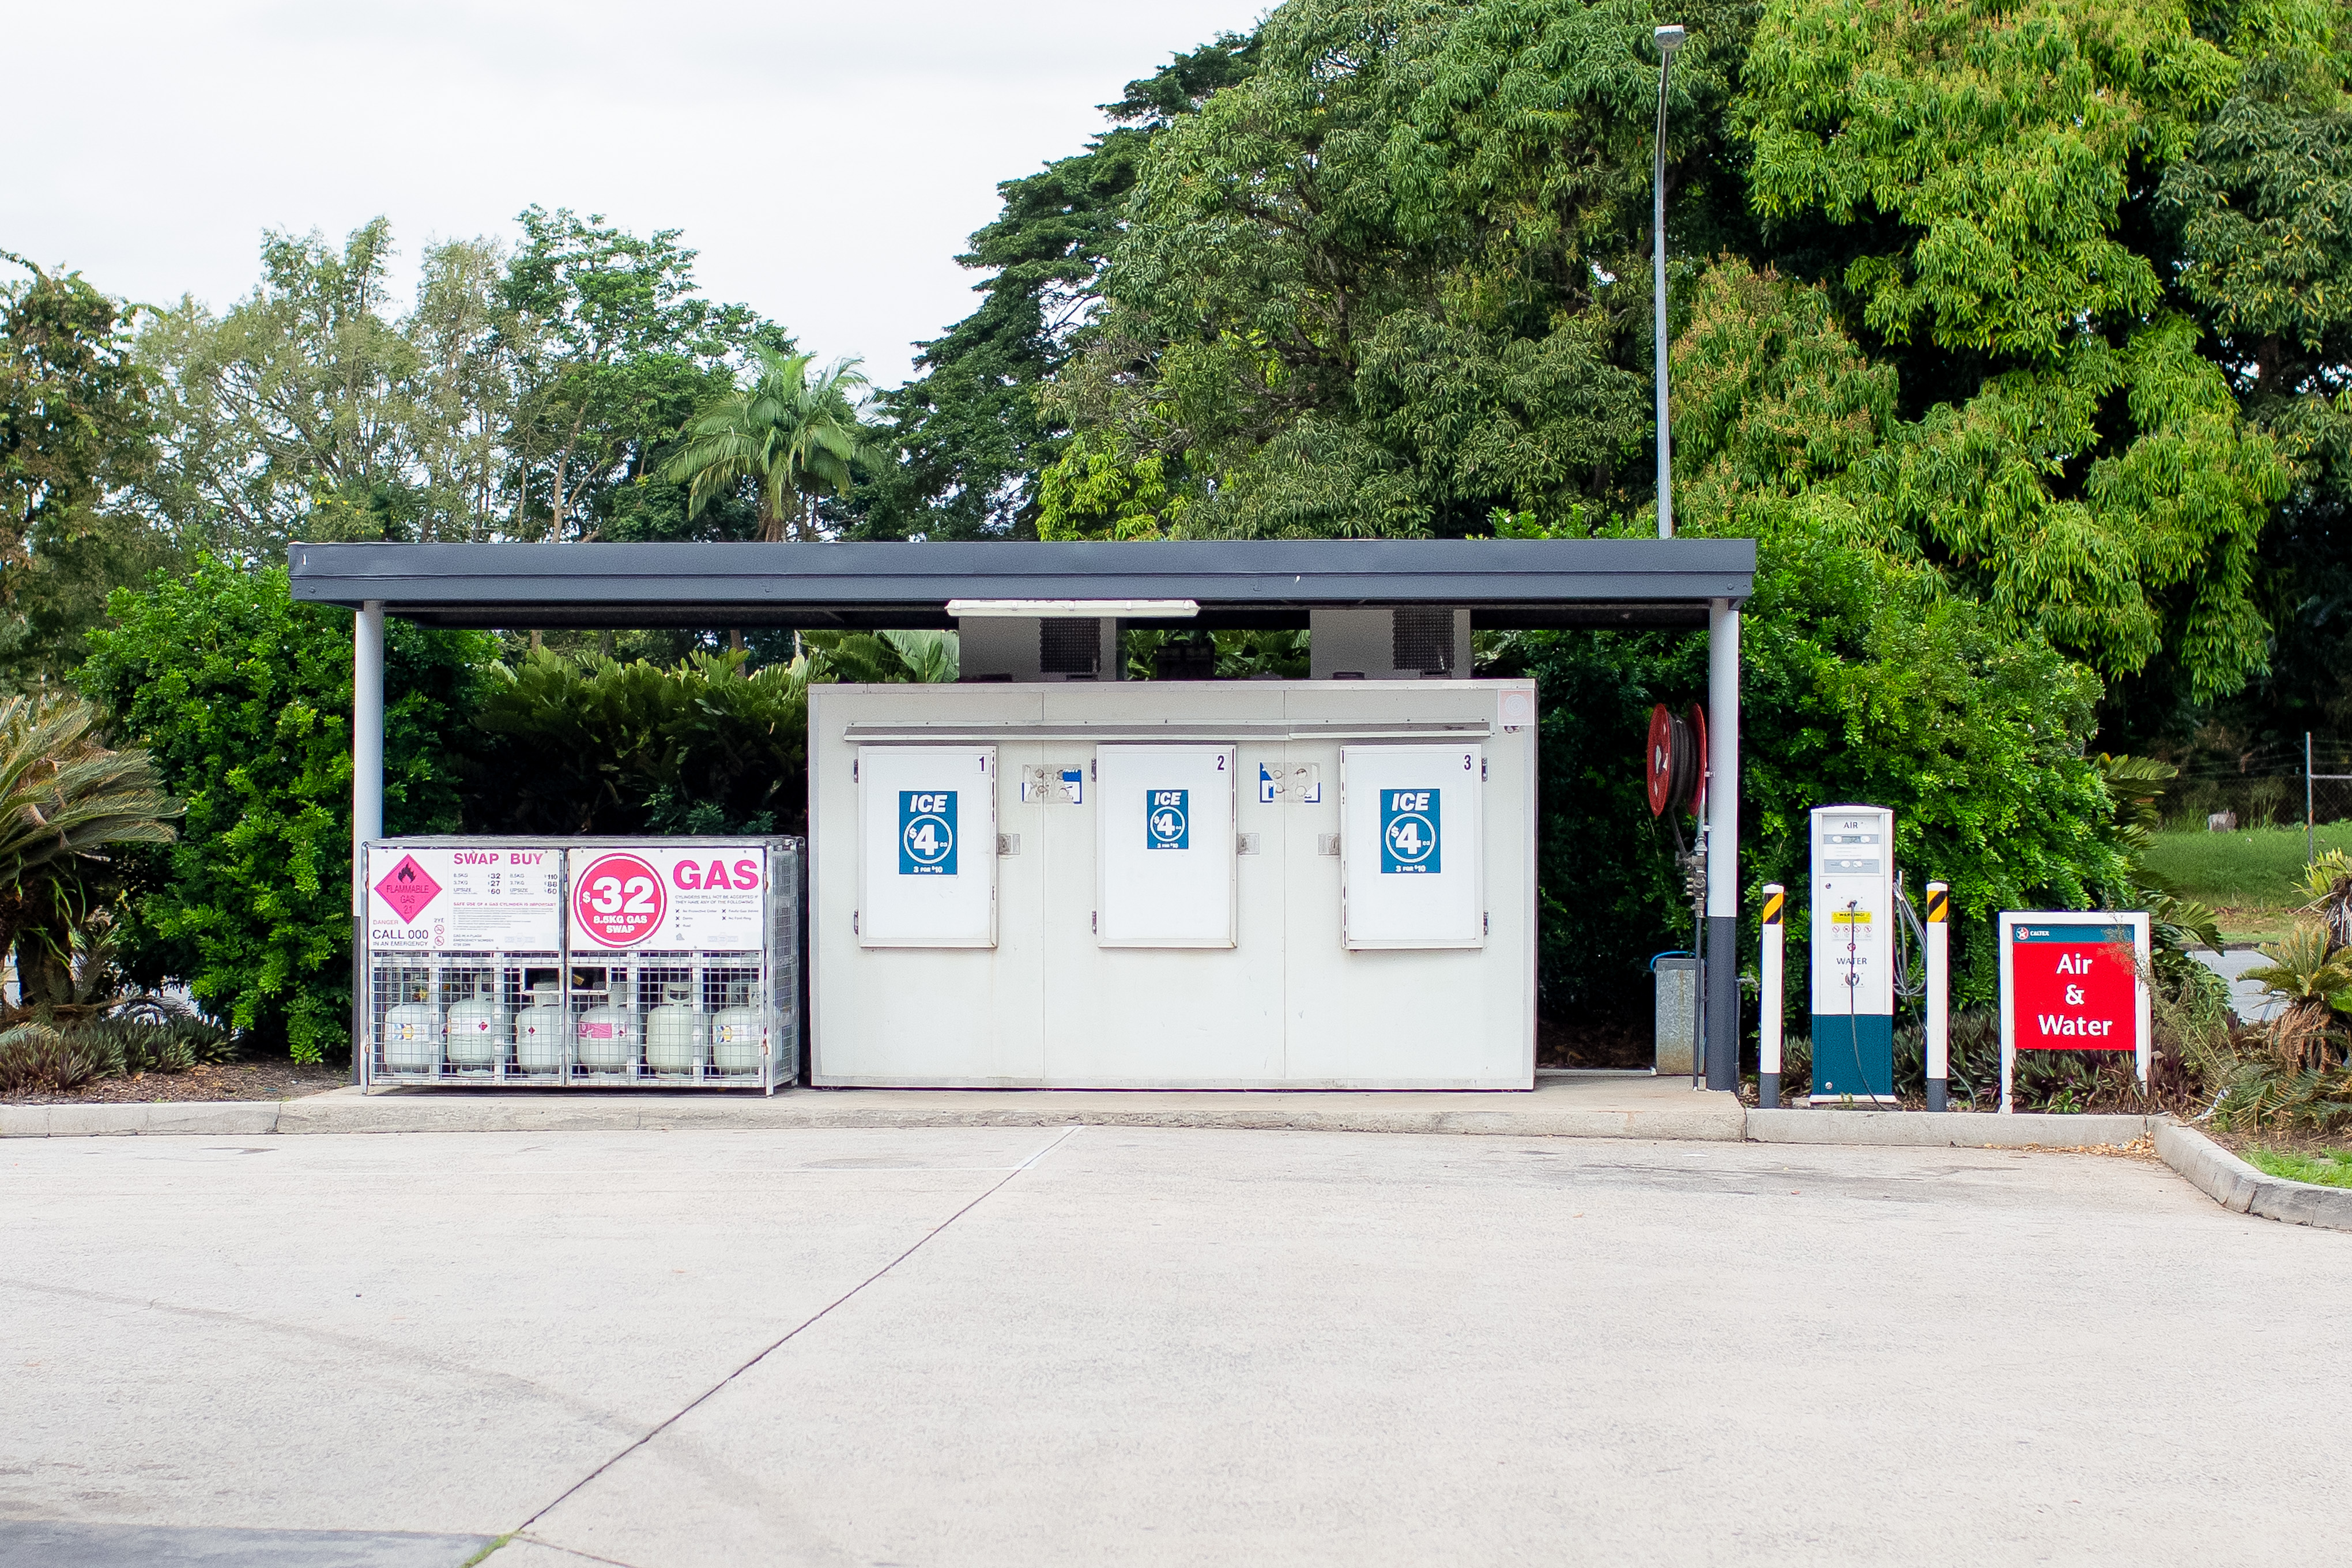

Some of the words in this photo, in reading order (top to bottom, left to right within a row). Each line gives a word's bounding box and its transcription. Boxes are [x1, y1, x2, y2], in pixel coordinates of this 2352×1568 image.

[979, 756, 985, 772] 1
[1217, 755, 1225, 771] 2
[1464, 755, 1472, 770] 3
[910, 794, 948, 813] ICE
[1154, 792, 1182, 806] ICE
[1392, 793, 1430, 812] ICE
[454, 853, 499, 865] SWAP
[511, 853, 543, 865] BUY
[673, 860, 759, 890] GAS
[386, 885, 429, 893] FLAMMABLE
[401, 895, 414, 903] GAS
[593, 915, 624, 924] 8.5KG
[626, 915, 647, 924] GAS
[372, 929, 405, 939] CALL
[408, 929, 429, 939] 000
[606, 925, 635, 933] SWAP
[2056, 953, 2093, 974] Air
[2065, 983, 2085, 1005] &
[2037, 1014, 2113, 1036] Water
